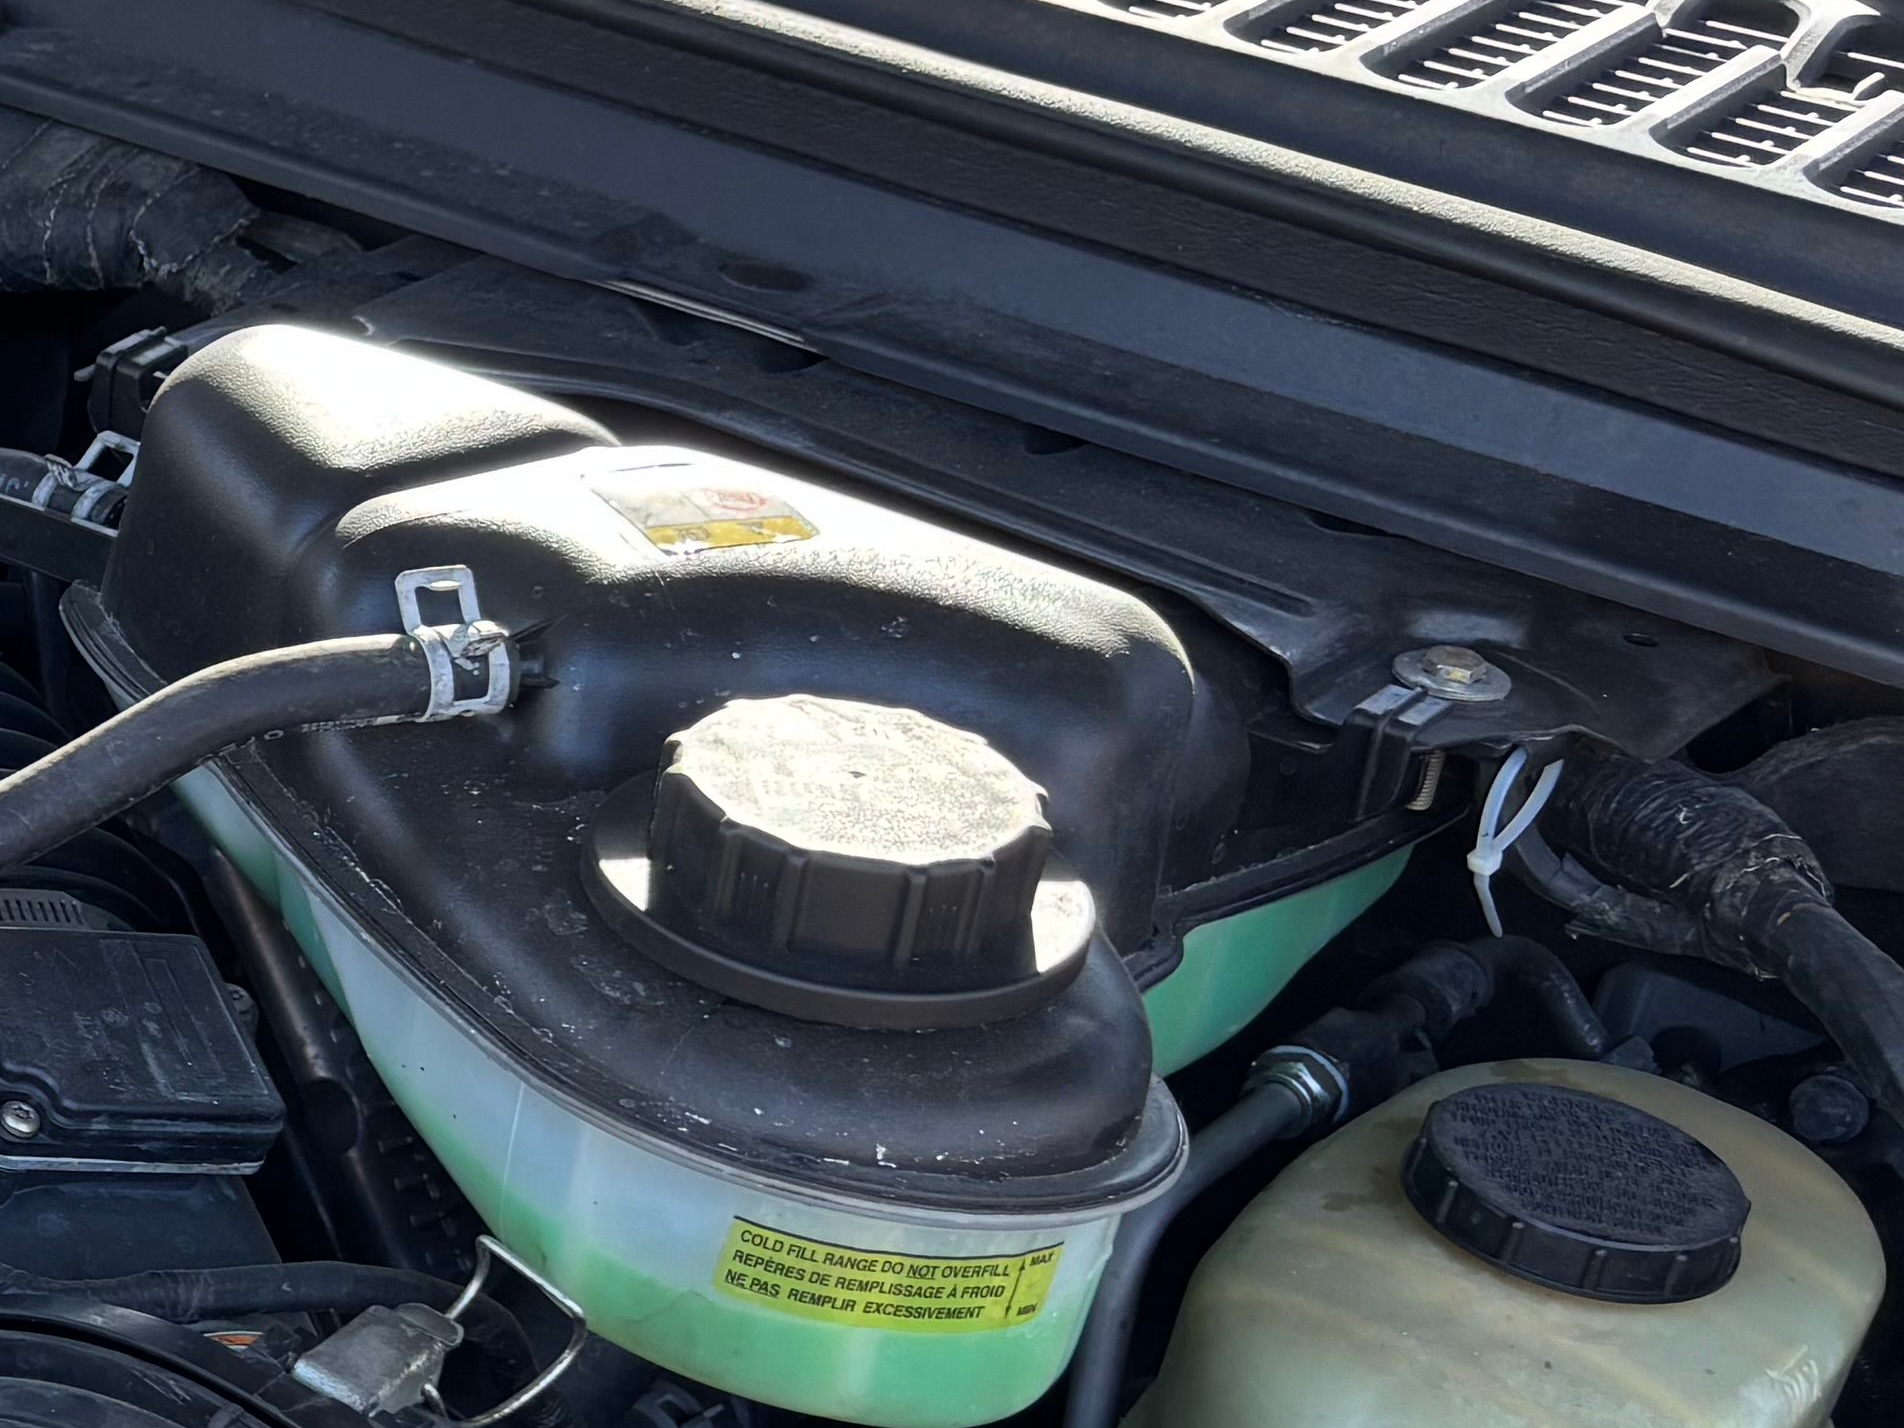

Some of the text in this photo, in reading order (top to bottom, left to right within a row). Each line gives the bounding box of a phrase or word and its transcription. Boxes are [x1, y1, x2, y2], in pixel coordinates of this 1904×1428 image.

[740, 1229, 1010, 1280] COLD FILL RANGE DO NOT OVERFILL
[1029, 1251, 1054, 1267] MAX
[725, 1269, 985, 1320] NE PAS REMPLIR EXCESSIVEMENT
[808, 1272, 833, 1287] DE
[834, 1277, 945, 1299] REMPLISSAGE
[960, 1285, 1006, 1299] FROID
